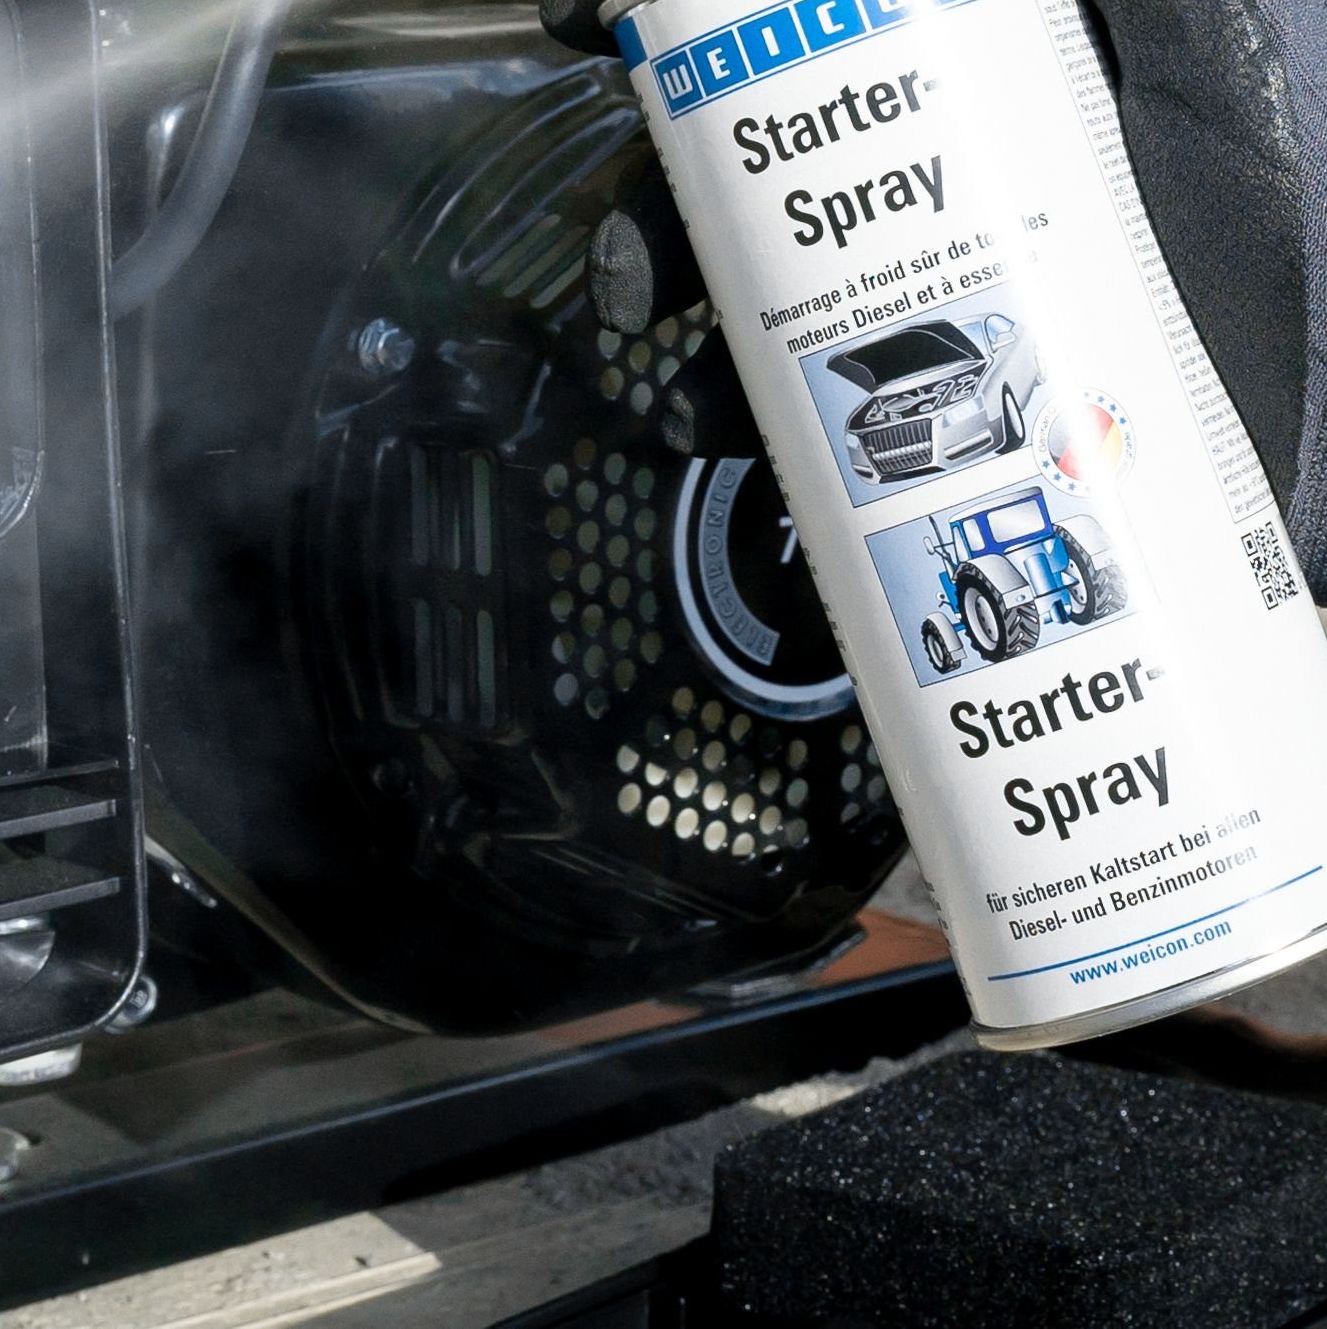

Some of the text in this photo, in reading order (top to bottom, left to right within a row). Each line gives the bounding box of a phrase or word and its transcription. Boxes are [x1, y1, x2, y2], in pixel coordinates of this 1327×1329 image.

[733, 68, 942, 175] Starter-
[784, 155, 945, 249] Spray
[760, 288, 842, 332] Démarrage
[847, 279, 858, 299] à
[861, 260, 906, 293] froid
[910, 250, 942, 274] sûr
[947, 242, 972, 260] de
[786, 318, 850, 354] moteurs
[852, 291, 913, 329] Diesel
[917, 284, 937, 304] et
[941, 276, 954, 296] à
[949, 657, 1165, 759] Starter-
[1004, 746, 1170, 841] Spray
[986, 892, 1008, 914] für
[1012, 874, 1088, 908] sicheren
[1089, 841, 1177, 885] Kaltstart
[1178, 825, 1211, 853] bei
[1008, 845, 1258, 941] Diesel- und Benzinmotoren
[1070, 920, 1233, 985] www.weicon.com
